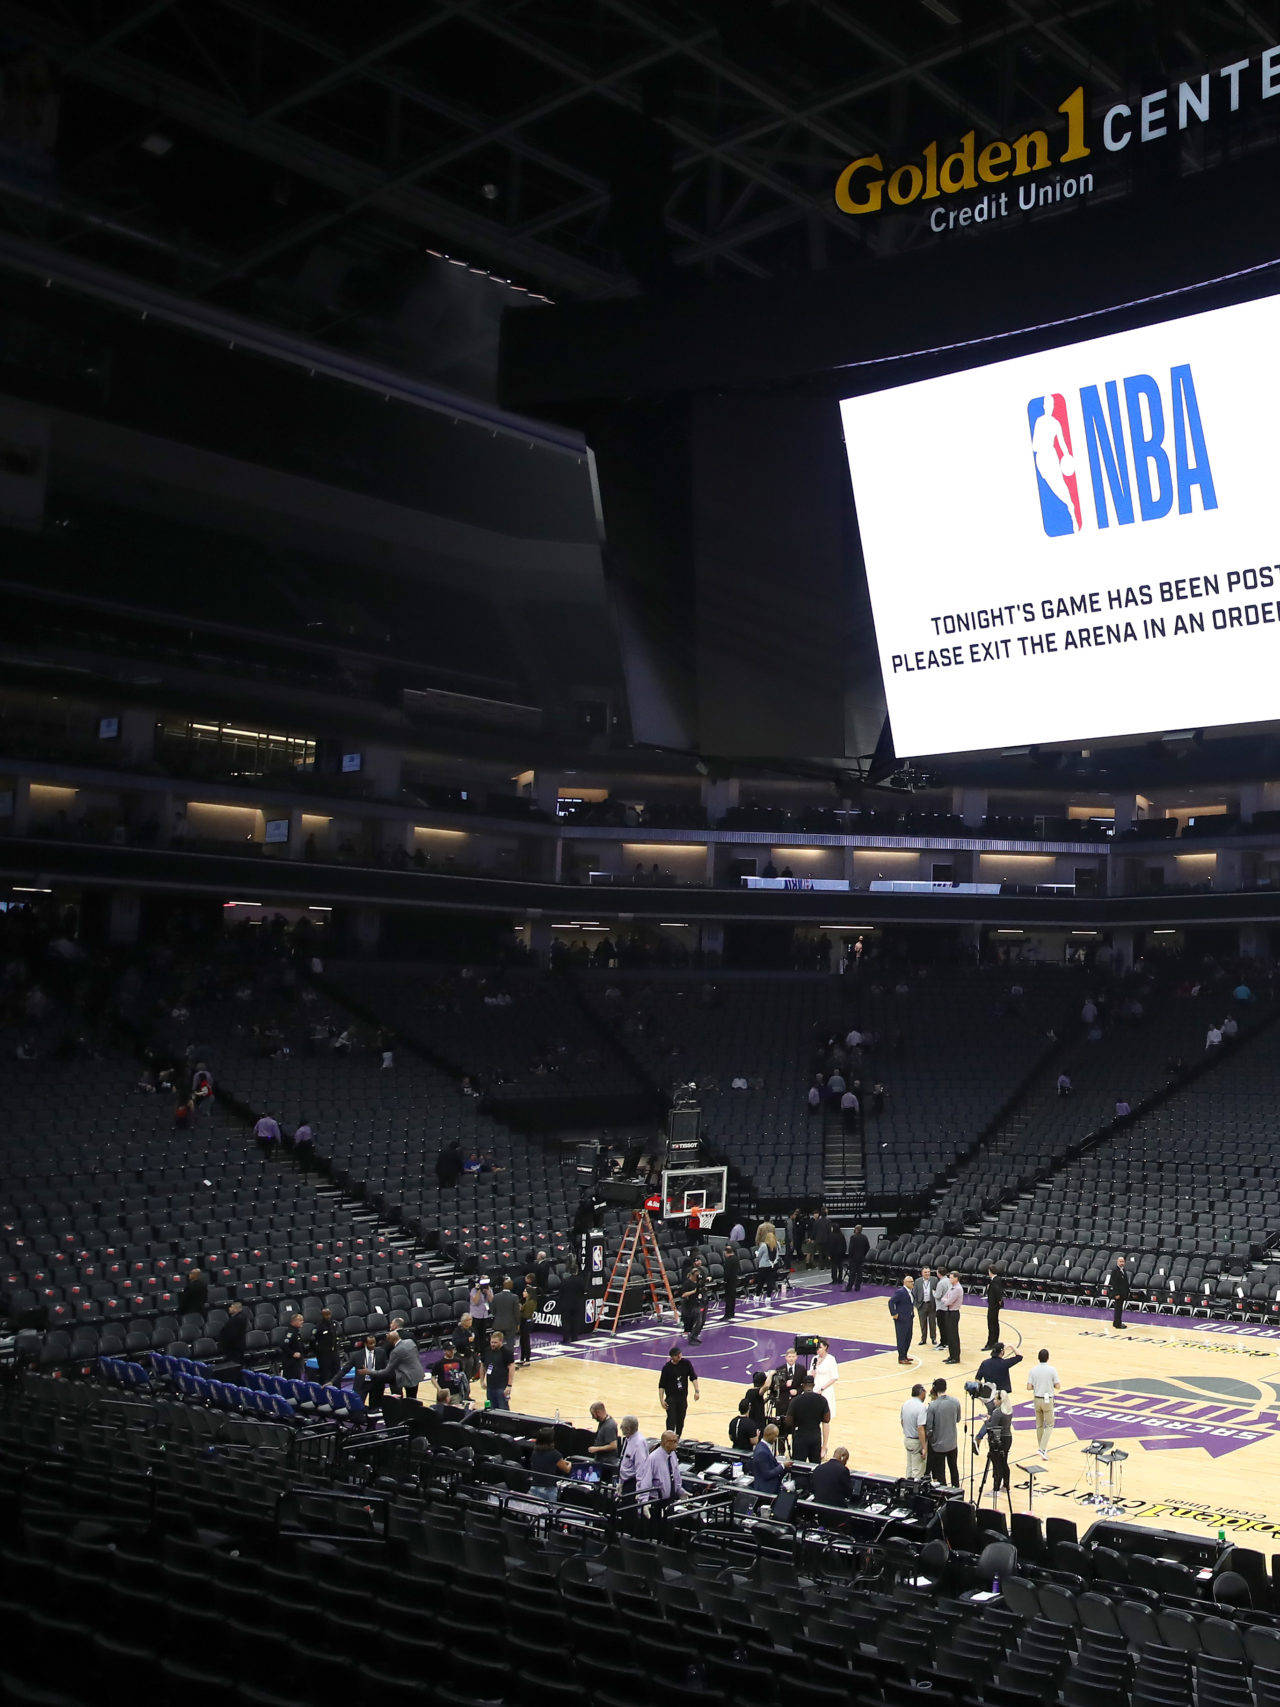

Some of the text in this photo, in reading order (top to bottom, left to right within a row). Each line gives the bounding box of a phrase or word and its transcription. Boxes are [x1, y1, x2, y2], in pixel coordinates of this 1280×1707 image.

[834, 129, 1052, 215] Golden
[929, 170, 1095, 234] Credit Union
[1080, 364, 1218, 529] NBA
[931, 603, 1035, 635] TONIGHT'S
[1041, 593, 1101, 619] GAME
[1108, 585, 1152, 609] HAS
[1160, 574, 1219, 602] BEEN
[892, 646, 964, 673] PLEASE
[970, 639, 1011, 662] EXIT
[1017, 633, 1057, 655] THE
[1065, 622, 1137, 650] ARENA
[1144, 618, 1166, 639] IN
[1174, 612, 1204, 635] AN
[1078, 1331, 1167, 1345] CENTER
[1215, 1507, 1268, 1520] Credit
